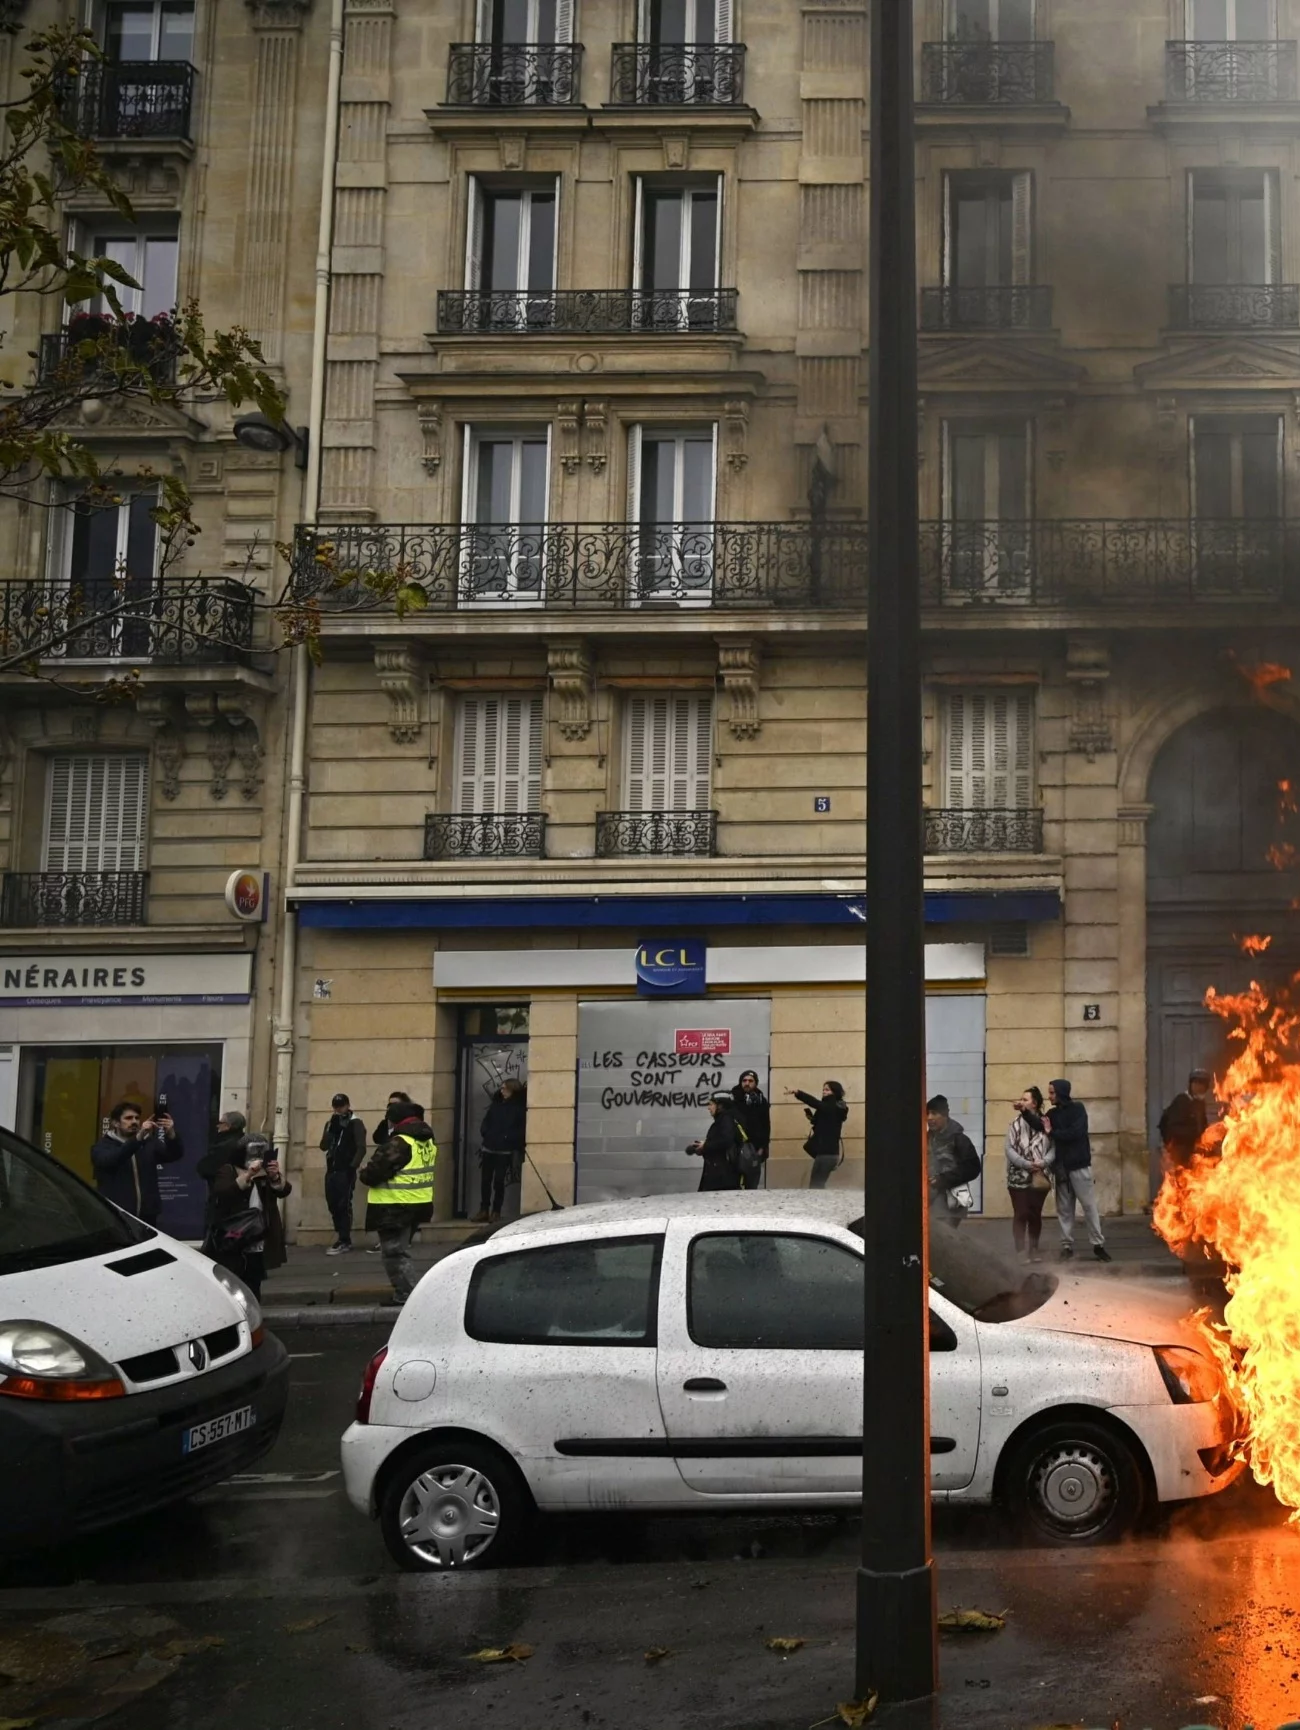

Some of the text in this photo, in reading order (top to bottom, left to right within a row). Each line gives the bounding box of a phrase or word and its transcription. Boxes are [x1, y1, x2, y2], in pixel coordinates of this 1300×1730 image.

[817, 798, 826, 811] 5
[239, 896, 255, 908] PFG
[641, 949, 697, 967] LCL
[4, 964, 146, 989] NÉRAIRES
[202, 994, 224, 1002] Fleurs
[1087, 1006, 1097, 1019] 5
[593, 1051, 624, 1068] LES
[636, 1050, 726, 1069] CASSEURS
[631, 1070, 723, 1088] SONT AU
[601, 1086, 711, 1110] GOUVERNEME
[190, 1408, 251, 1449] CS-557-MT
